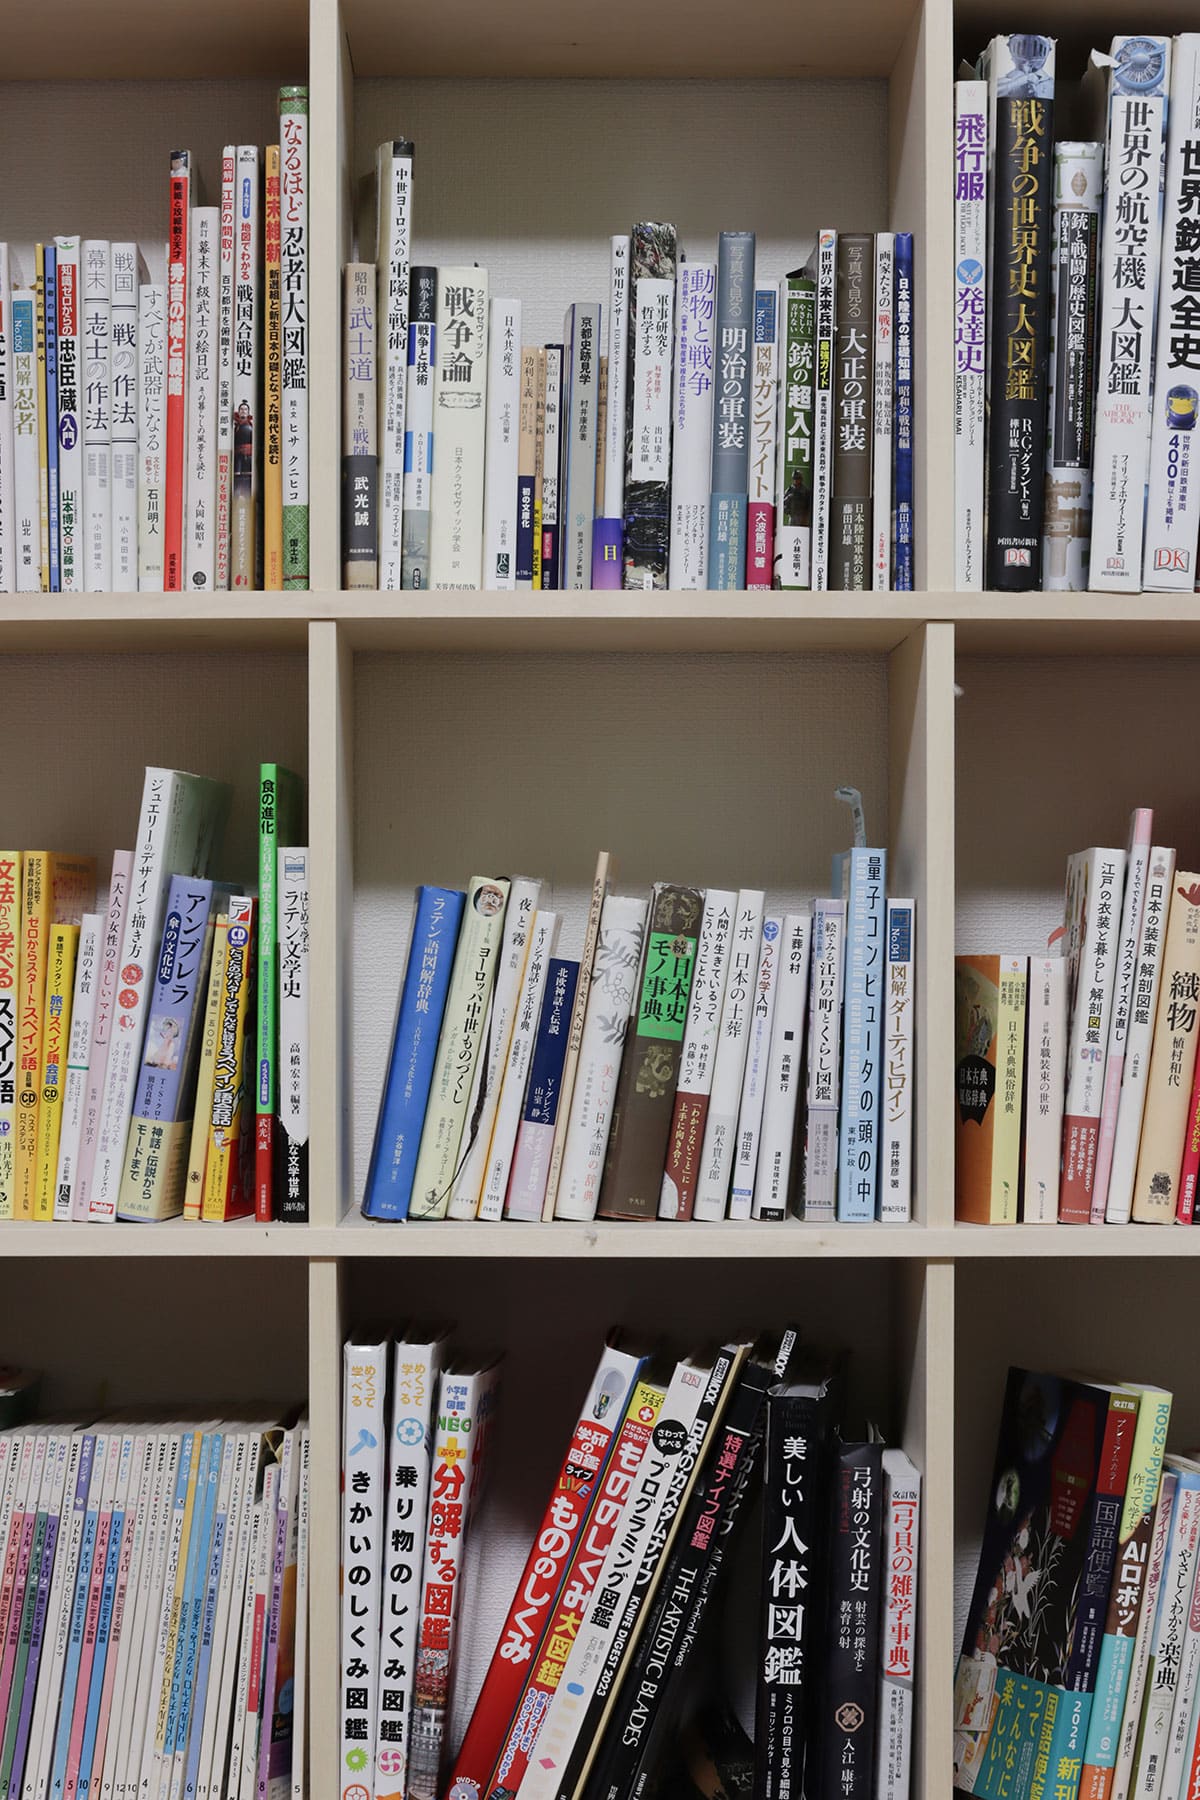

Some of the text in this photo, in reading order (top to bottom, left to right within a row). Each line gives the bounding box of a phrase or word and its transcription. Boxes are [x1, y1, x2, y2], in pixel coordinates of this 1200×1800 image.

[283, 119, 304, 222] なるほど
[955, 113, 985, 201] 飛行服
[222, 191, 233, 262] 江戸の間取り
[241, 223, 250, 281] 地図でわかる
[1005, 100, 1045, 400] 戦争の世界史大図鑑
[1107, 100, 1154, 395] 世界の航空機大図鑑
[1167, 140, 1200, 371] 世界鉄道全史
[87, 250, 106, 289] 幕末
[115, 252, 134, 293] 戦国
[613, 267, 625, 326] 軍用センサー
[729, 246, 744, 317] 写真で見る
[819, 251, 832, 337] 世界の未来兵器
[848, 247, 862, 318] 写真で見る
[1068, 213, 1089, 350] 銃と戦闘の歴史図鑑
[196, 242, 210, 381] 幕末下級武士の絵日記
[236, 285, 253, 376] 戦国合戦史
[282, 226, 306, 390] 忍者大図鑑
[442, 286, 475, 383] 戦争論
[641, 307, 653, 356] 哲学する
[656, 294, 669, 356] 軍事研究を
[688, 269, 714, 396] 動物と戦争
[898, 278, 911, 380] 日本陸軍の基礎知識
[954, 287, 985, 374] 発達史
[59, 339, 77, 412] 忠臣蔵
[85, 313, 109, 431] 志士の作法
[112, 323, 136, 425] 戦の作法
[144, 291, 163, 451] すべてが武器になる
[416, 325, 430, 386] 戦争と技術
[503, 316, 514, 377] 日本共産党
[524, 356, 534, 398] 功利主義
[579, 317, 593, 385] 京都史跡見学
[719, 328, 747, 448] 明治の軍装
[840, 328, 868, 451] 大正の軍装
[61, 416, 76, 447] 入門
[147, 489, 159, 535] 石川明人
[354, 476, 369, 526] 武光誠
[1007, 548, 1029, 564] DK
[1157, 549, 1186, 569] DK
[260, 779, 274, 834] 食の進化
[127, 779, 164, 959] ジュエリーのデザインと描き方
[0, 860, 15, 989] 文法から学べる
[159, 915, 181, 980] 傘の文化史
[171, 892, 207, 1005] アンブレラ
[283, 891, 301, 1000] ラテン文学史
[511, 897, 532, 948] 夜と霧
[789, 926, 804, 974] 土葬の村
[80, 933, 96, 994] 言語の本質
[416, 897, 445, 1015] ラテン語図解辞典
[641, 939, 670, 1022] モノ事典
[692, 907, 715, 1024] こういうことかしら?
[705, 907, 730, 1022] 人間が生きているって
[755, 944, 773, 1018] うんち学入門
[548, 967, 569, 1035] 北欧神話と伝説
[664, 957, 690, 1023] 日本史
[1167, 971, 1199, 1032] 織物
[21, 1007, 38, 1070] スペイン語
[453, 947, 491, 1104] ヨーロッパ中世ものづくし
[857, 856, 882, 1203] 量子コンピュータの頭の中
[1004, 1021, 1017, 1114] 日本古典風俗辞典
[1038, 1036, 1051, 1115] 有職装束の世界
[1167, 1037, 1184, 1087] 植村和代
[21, 1093, 36, 1103] CD
[130, 1124, 147, 1182] モードまで
[351, 1366, 363, 1408] 学べる
[365, 1365, 376, 1408] めくって
[401, 1364, 413, 1404] 学べる
[414, 1364, 426, 1407] めくって
[446, 1401, 466, 1411] 図鑑
[1113, 1400, 1136, 1411] 改訂版
[438, 1416, 472, 1433] NEO
[577, 1425, 610, 1448] 学研
[657, 1428, 685, 1439] さわって
[659, 1438, 682, 1449] 学べる
[1151, 1403, 1170, 1445] ROS2
[558, 1477, 591, 1499] LIVE
[566, 1464, 594, 1481] ライブ
[568, 1448, 601, 1470] 図鑑
[1141, 1456, 1162, 1514] Python
[689, 1434, 744, 1550] 特選ナイフ図鑑
[892, 1490, 917, 1500] 改訂版
[421, 1464, 465, 1649] 分解する図鑑
[590, 1461, 670, 1630] プログラミング図鑑
[849, 1466, 873, 1592] 弓射の文化史
[1084, 1501, 1119, 1599] 国語便覧
[499, 1495, 578, 1664] もののしくみ
[763, 1436, 809, 1685] 美しい人体図鑑
[345, 1471, 372, 1740] きかいのしくみ図鑑
[380, 1466, 419, 1742] 乗り物のしくみ図鑑
[838, 1601, 851, 1649] 教育の射
[596, 1595, 641, 1697] KNIFE DIGEST 2023
[622, 1567, 698, 1748] THE ARTISTIC BLADES
[853, 1601, 866, 1672] 射芸の探求と
[1154, 1642, 1181, 1692] 楽典
[997, 1684, 1025, 1797] こんなに
[1027, 1690, 1044, 1737] って
[1068, 1701, 1082, 1751] 2024
[2, 1780, 8, 1790] 2
[26, 1784, 32, 1792] 6
[55, 1779, 60, 1788] 4
[68, 1780, 73, 1790] 5
[80, 1780, 88, 1789] 10
[94, 1778, 99, 1787] 7
[116, 1784, 126, 1792] 12
[128, 1784, 136, 1792] 10
[142, 1779, 148, 1787] 4
[187, 1782, 192, 1792] 6
[259, 1781, 265, 1791] 8
[1054, 1756, 1081, 1800] 新刊
